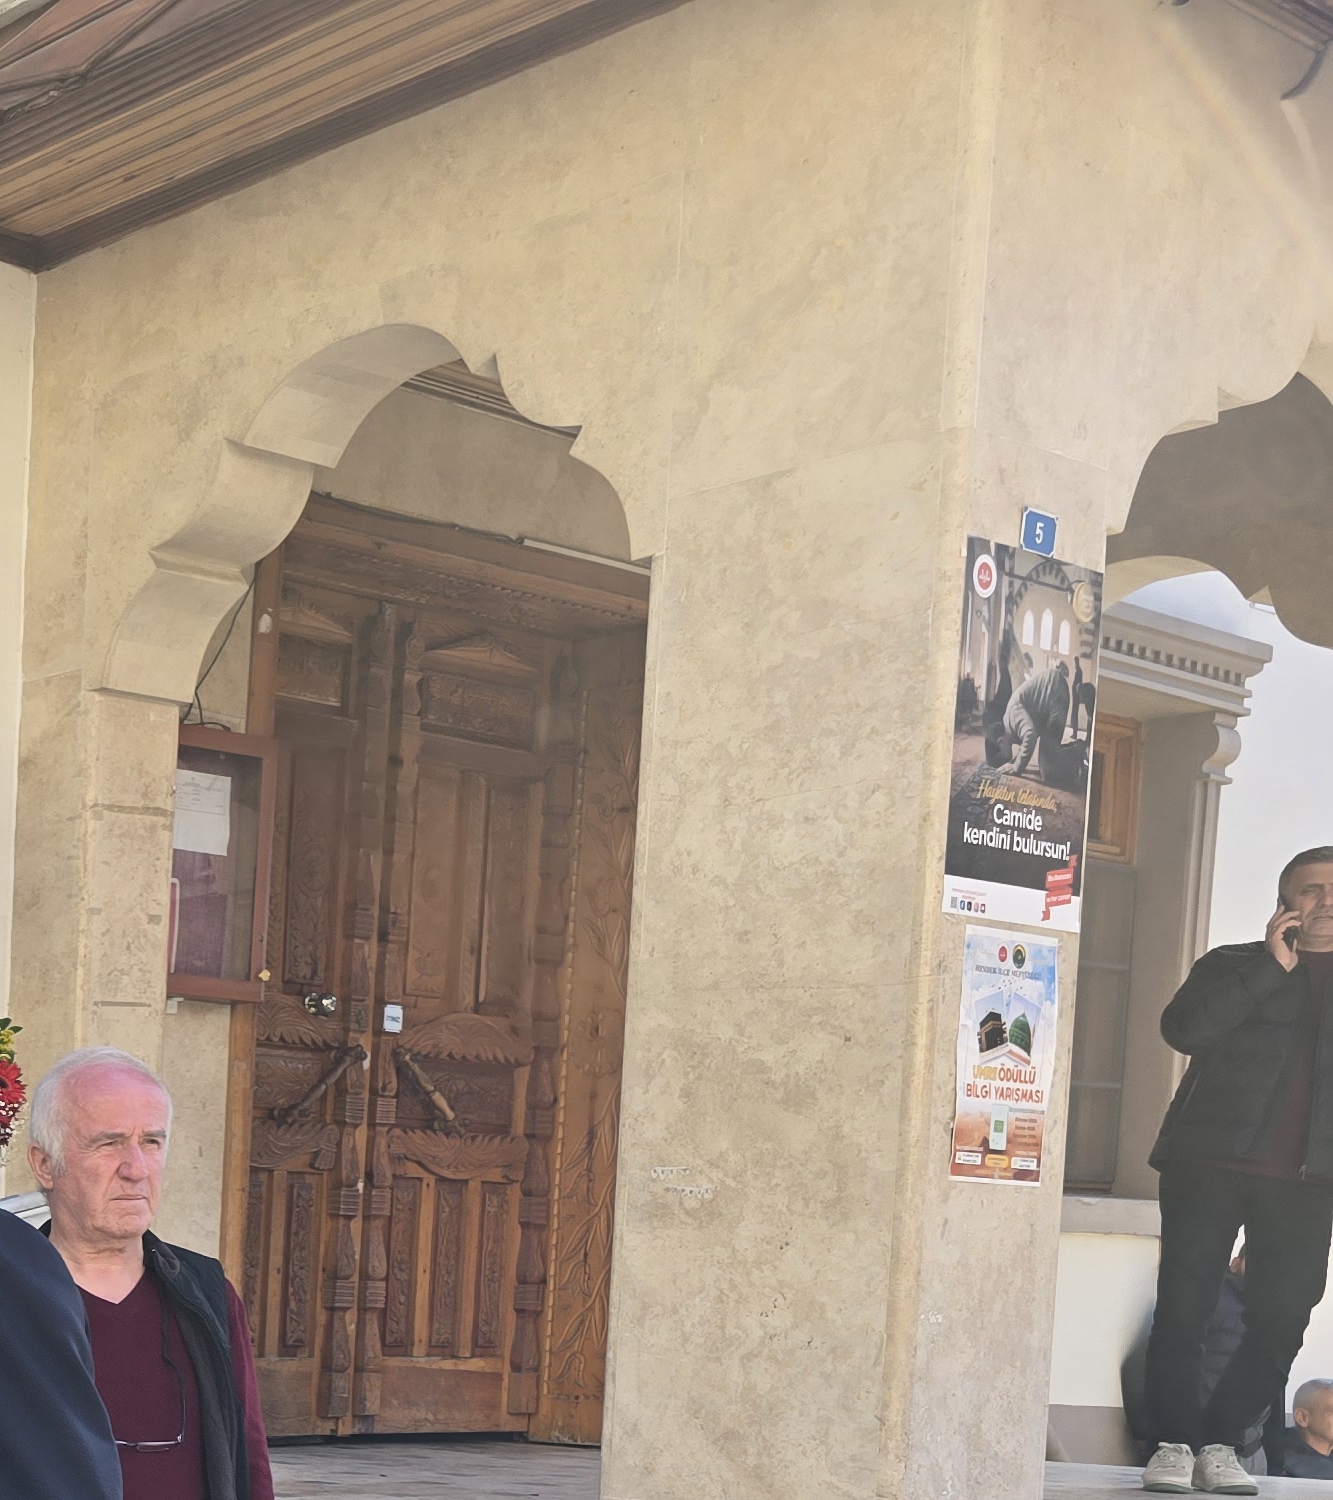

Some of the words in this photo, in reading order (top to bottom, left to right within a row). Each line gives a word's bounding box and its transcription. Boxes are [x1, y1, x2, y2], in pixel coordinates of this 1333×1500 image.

[1035, 522, 1044, 544] 5
[993, 803, 1043, 831] Camide
[963, 821, 1012, 850] kendini
[1012, 830, 1071, 860] bulursun!
[998, 1063, 1036, 1085] ÖDÜLLÜ
[966, 1081, 992, 1100] BİLGİ
[994, 1085, 1044, 1104] YARIŞMASI
